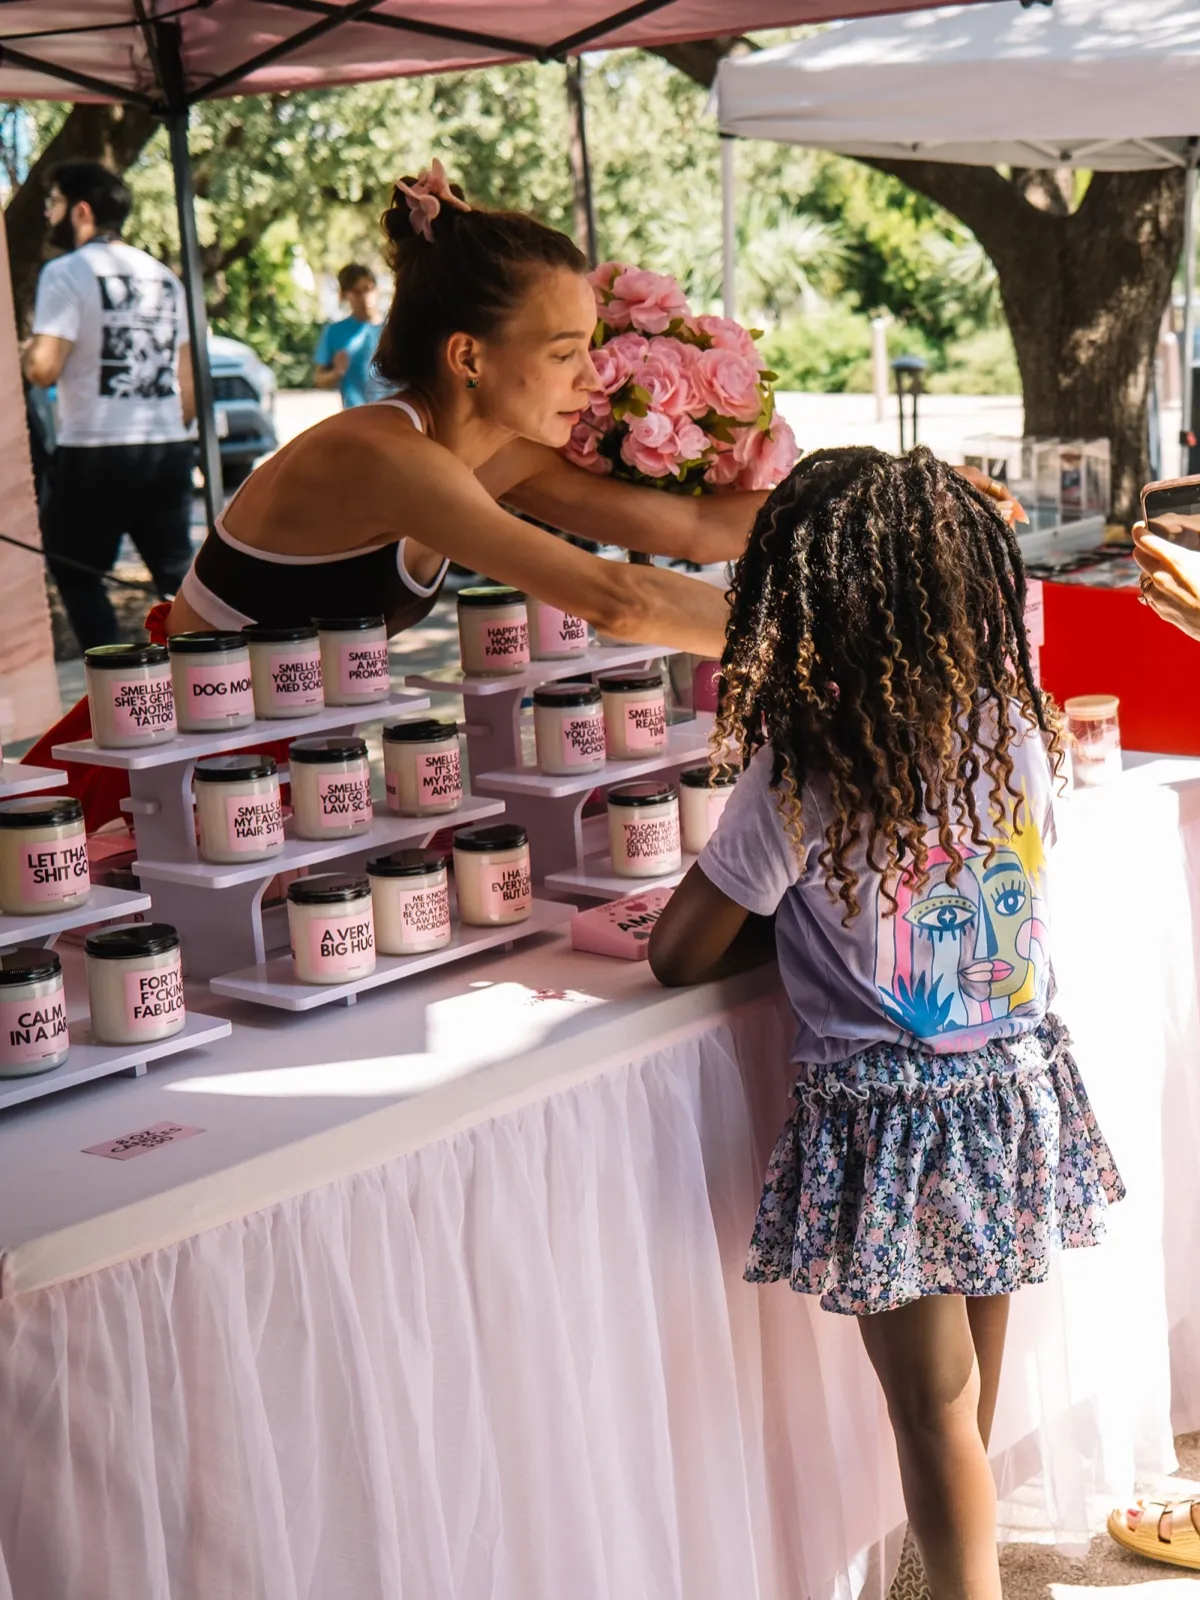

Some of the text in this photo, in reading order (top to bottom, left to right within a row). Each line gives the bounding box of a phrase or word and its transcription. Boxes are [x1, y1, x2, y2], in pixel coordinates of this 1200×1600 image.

[563, 619, 582, 630] BAD
[487, 626, 519, 637] HAPPY
[559, 628, 585, 641] VIBES
[491, 635, 519, 646] HOME
[349, 650, 381, 661] SMELLS
[485, 644, 518, 655] FANCY
[279, 661, 314, 674] SMELLS
[272, 673, 296, 682] YOU
[300, 670, 316, 681] GOT
[121, 682, 161, 696] SMELLS
[193, 683, 227, 697] DOG
[276, 682, 299, 693] MED
[115, 695, 147, 707] SHE'S
[130, 701, 173, 716] ANOTHER
[628, 706, 662, 720] SMELLS
[135, 712, 173, 726] TATTOO
[570, 718, 599, 730] SMELLS
[564, 730, 585, 739] YOU
[587, 727, 600, 737] GOT
[649, 725, 664, 737] TIME
[572, 735, 605, 748] PHARMA
[580, 744, 605, 755] SCHOO
[425, 752, 457, 767] SMELLS
[435, 765, 450, 775] IT'S
[423, 776, 440, 786] MY
[328, 782, 363, 794] SMELLS
[432, 781, 462, 796] ANYMO
[320, 793, 345, 804] YOU
[238, 801, 275, 817] SMELLS
[324, 804, 350, 814] LAW
[235, 817, 253, 828] MY
[237, 827, 263, 838] HAIR
[630, 830, 660, 838] PERSON
[646, 842, 660, 850] TELL
[28, 843, 87, 869] LET THAT
[33, 860, 88, 884] SHIT GO
[502, 866, 528, 881] I HATE
[492, 877, 531, 892] EVERYON
[413, 894, 424, 902] ME
[503, 887, 530, 900] BUT US
[415, 907, 437, 917] OKAY
[410, 916, 430, 925] SAW
[322, 921, 370, 942] A VERY
[320, 934, 373, 957] BIG HUG
[140, 969, 178, 991] FORTY
[18, 1003, 62, 1028] CALM
[10, 1018, 68, 1046] IN A JAR
[111, 1127, 182, 1152] CANDLES
